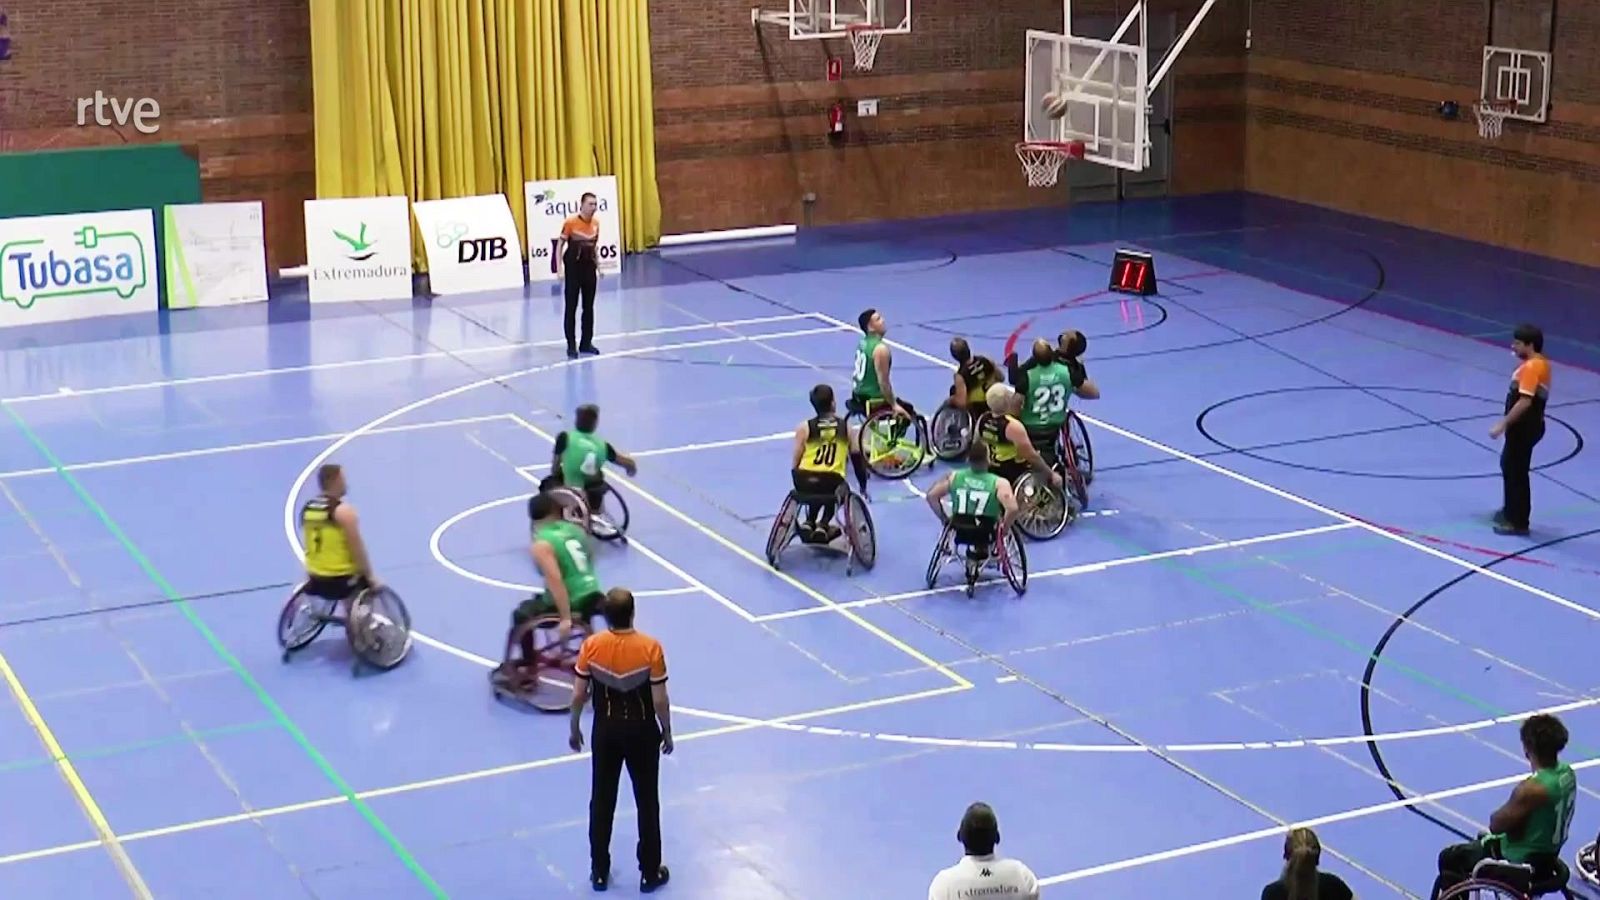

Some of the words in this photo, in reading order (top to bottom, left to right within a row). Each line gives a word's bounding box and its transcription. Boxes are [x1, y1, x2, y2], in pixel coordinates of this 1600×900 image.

[458, 236, 508, 264] DTB
[8, 249, 134, 291] Tubasa
[313, 264, 407, 281] Extremadura
[1121, 262, 1145, 288] 11
[1031, 384, 1066, 413] 23
[956, 488, 990, 516] 17
